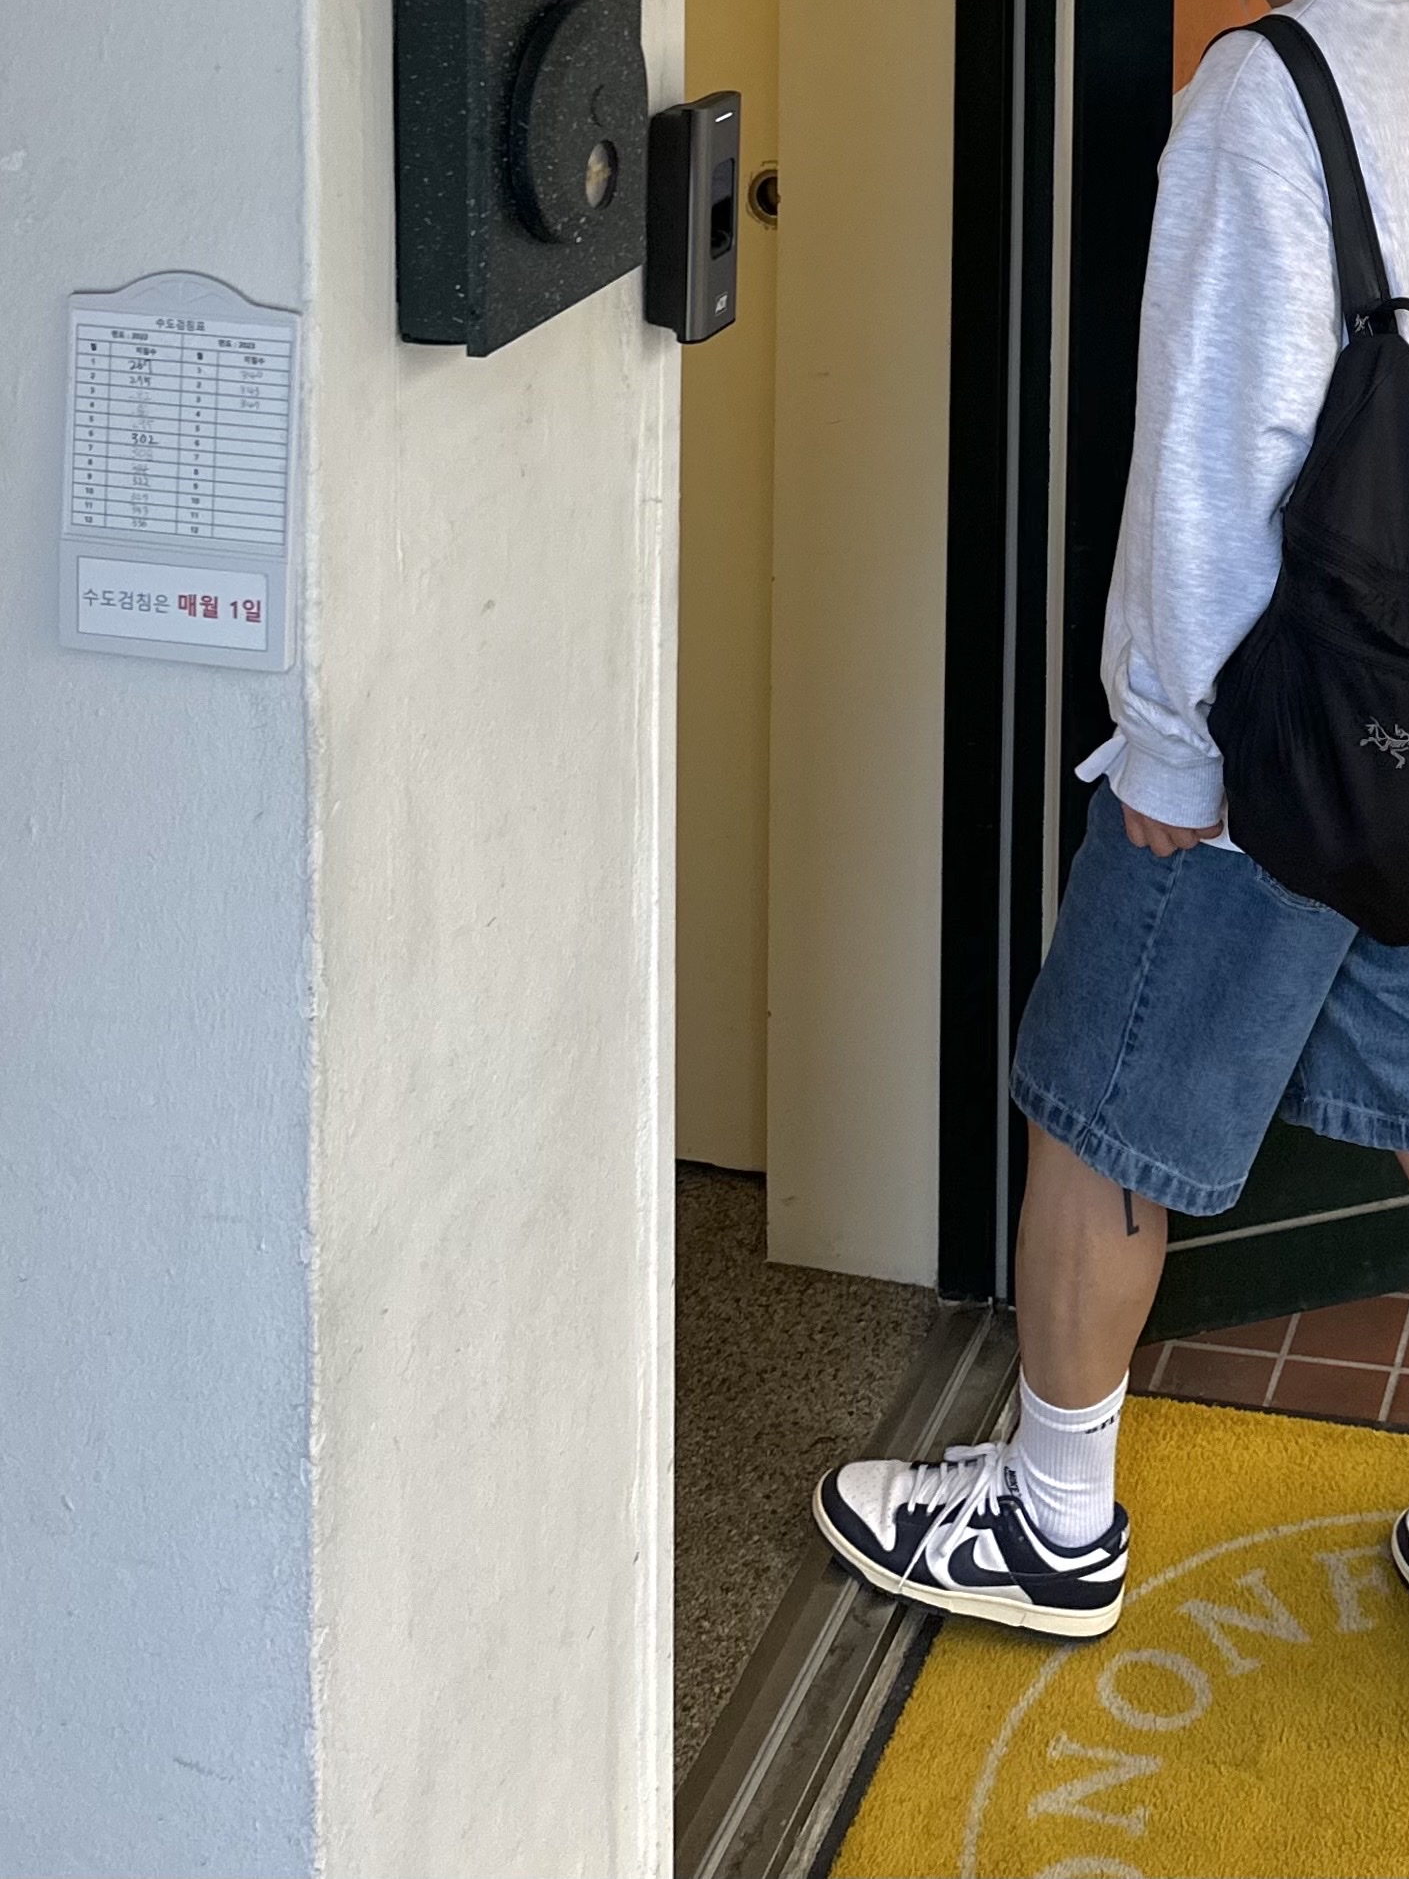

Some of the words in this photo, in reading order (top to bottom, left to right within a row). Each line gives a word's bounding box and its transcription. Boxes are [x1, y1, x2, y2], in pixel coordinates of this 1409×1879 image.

[131, 432, 160, 444] 302
[82, 588, 171, 614] 수도검침은
[178, 593, 219, 619] 매월
[229, 599, 262, 623] 1일
